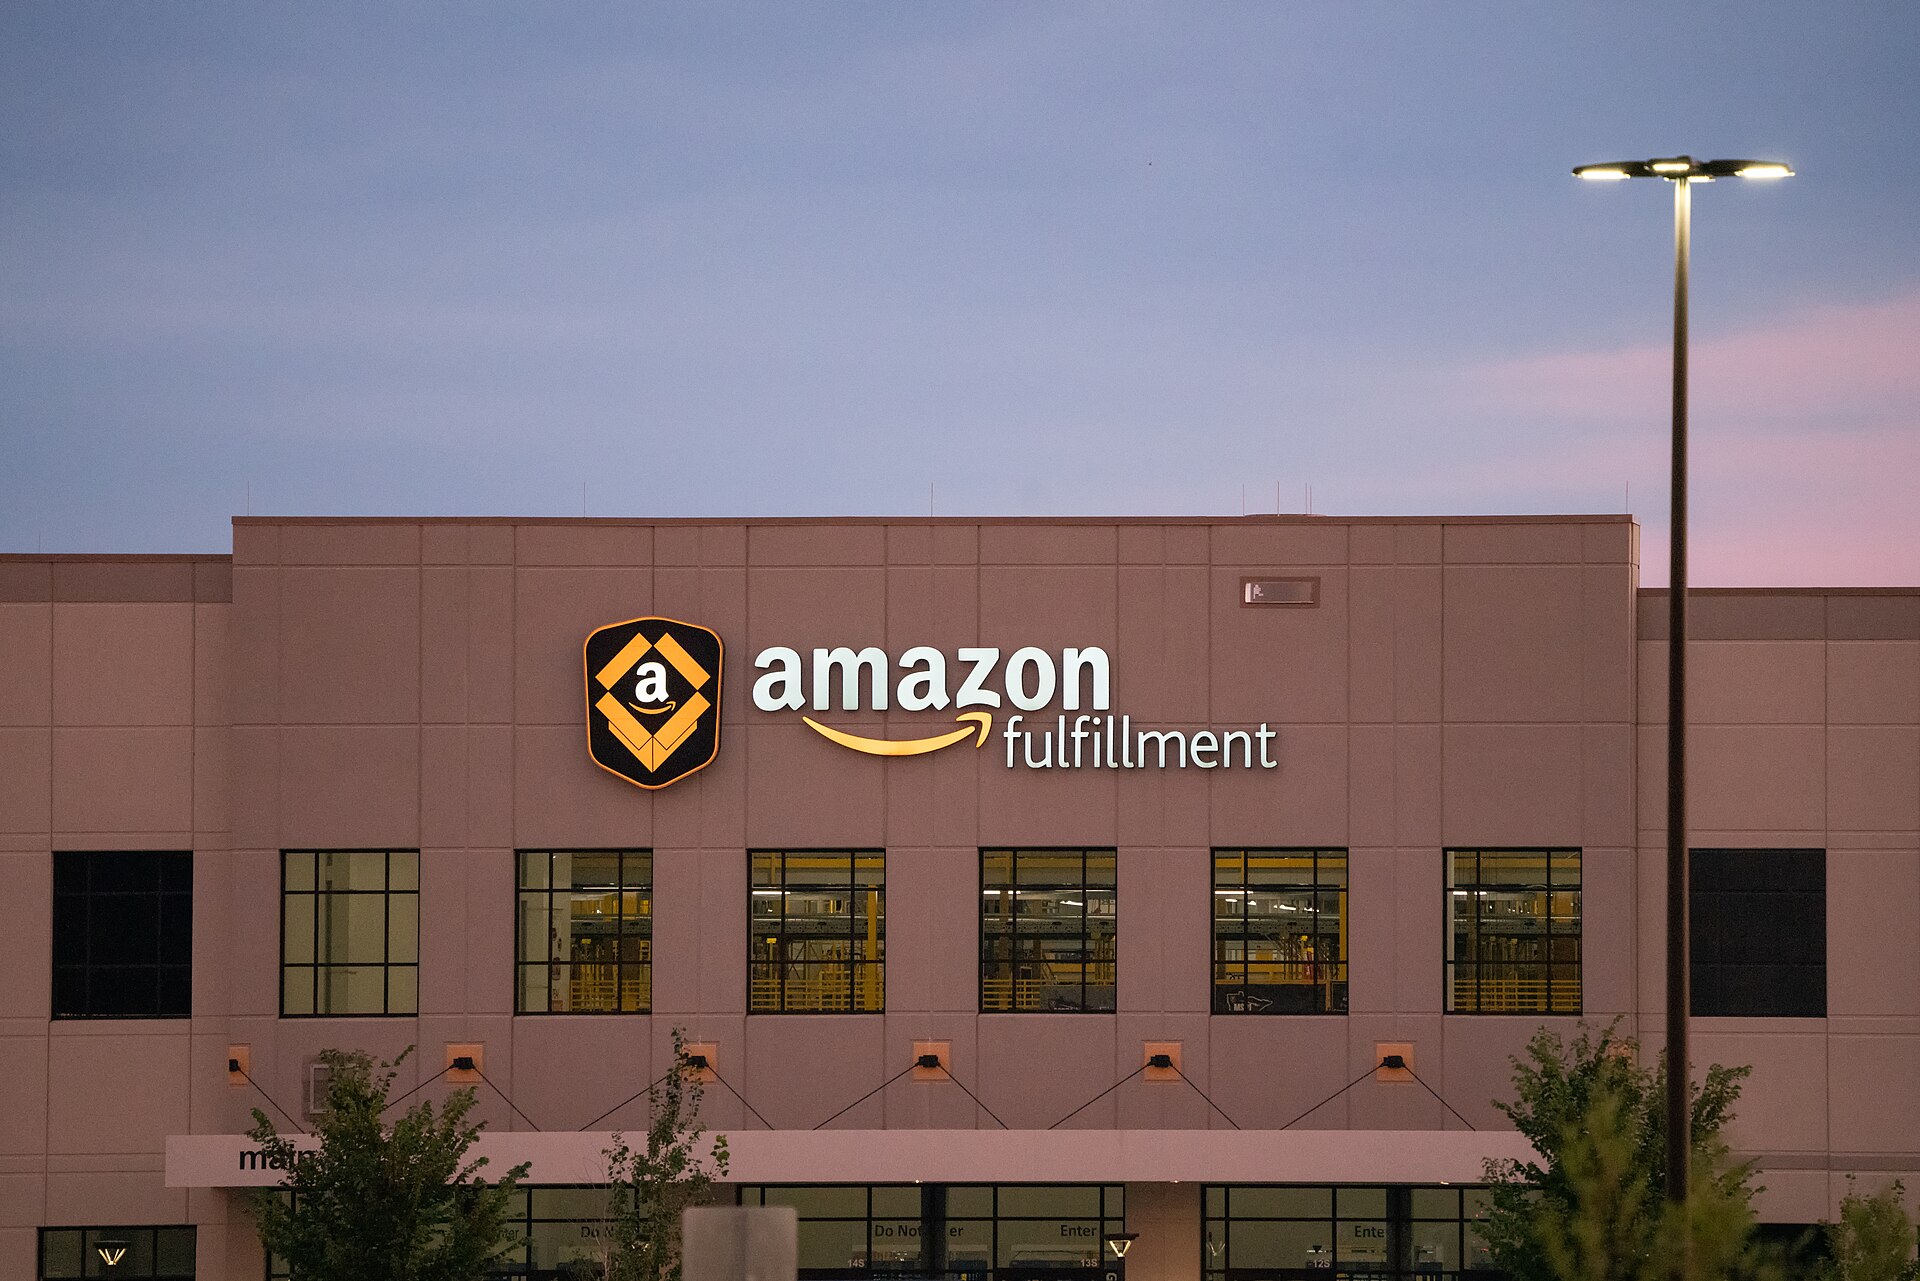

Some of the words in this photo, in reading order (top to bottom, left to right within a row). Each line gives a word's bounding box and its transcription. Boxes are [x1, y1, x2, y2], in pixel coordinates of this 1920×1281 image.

[635, 661, 669, 703] a
[751, 645, 1111, 712] amazon
[1003, 714, 1278, 769] fulfillment
[874, 1225, 893, 1237] Do
[1060, 1225, 1097, 1237] Enter
[1354, 1226, 1385, 1238] Ente
